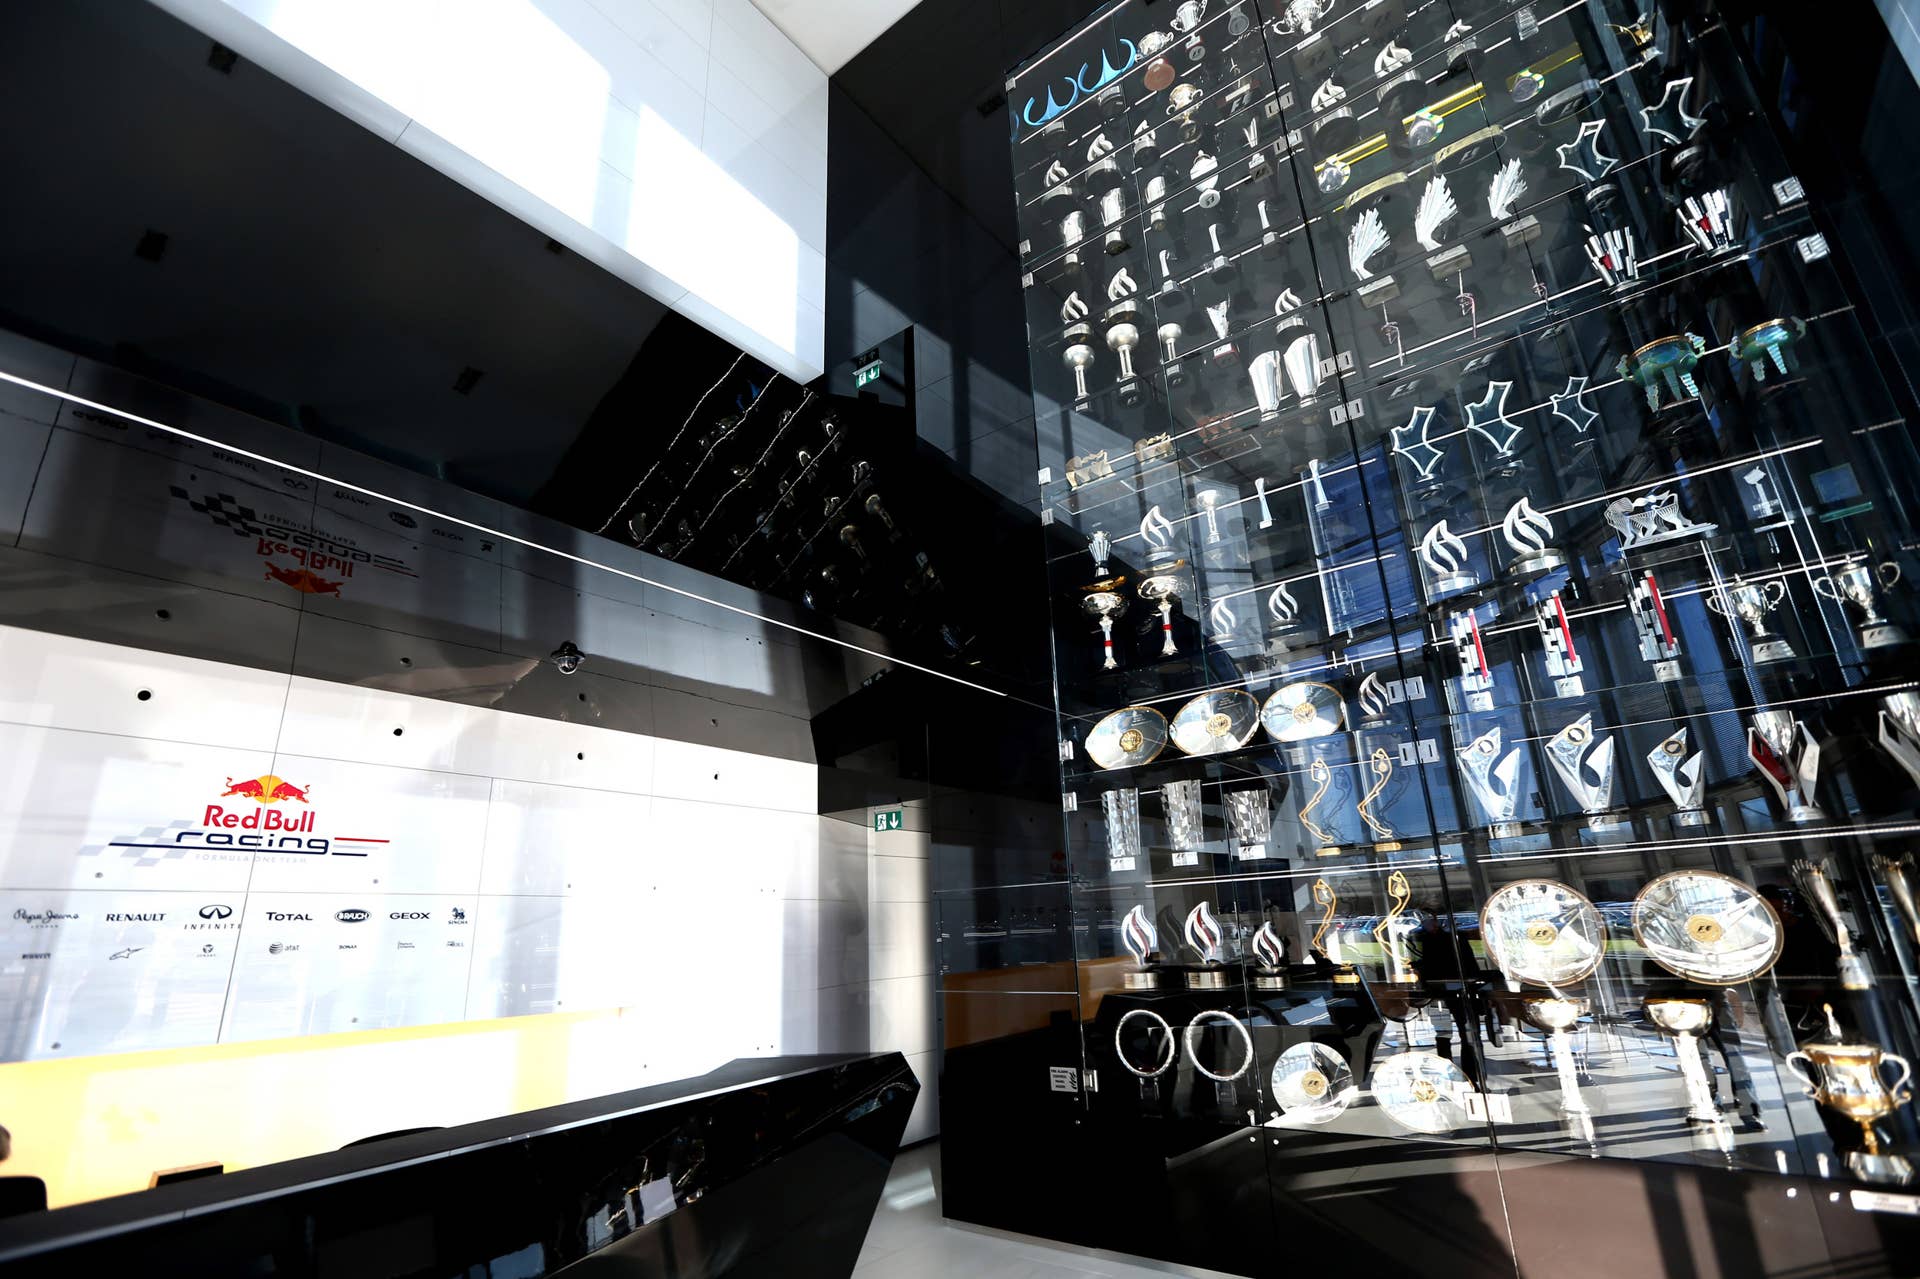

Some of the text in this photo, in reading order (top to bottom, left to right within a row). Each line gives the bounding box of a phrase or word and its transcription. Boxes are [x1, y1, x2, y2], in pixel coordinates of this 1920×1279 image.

[203, 805, 315, 832] Red Bull
[176, 832, 330, 855] racing
[106, 913, 167, 922] RENAULT
[266, 912, 313, 921] TOTAL
[389, 912, 431, 920] GEOX
